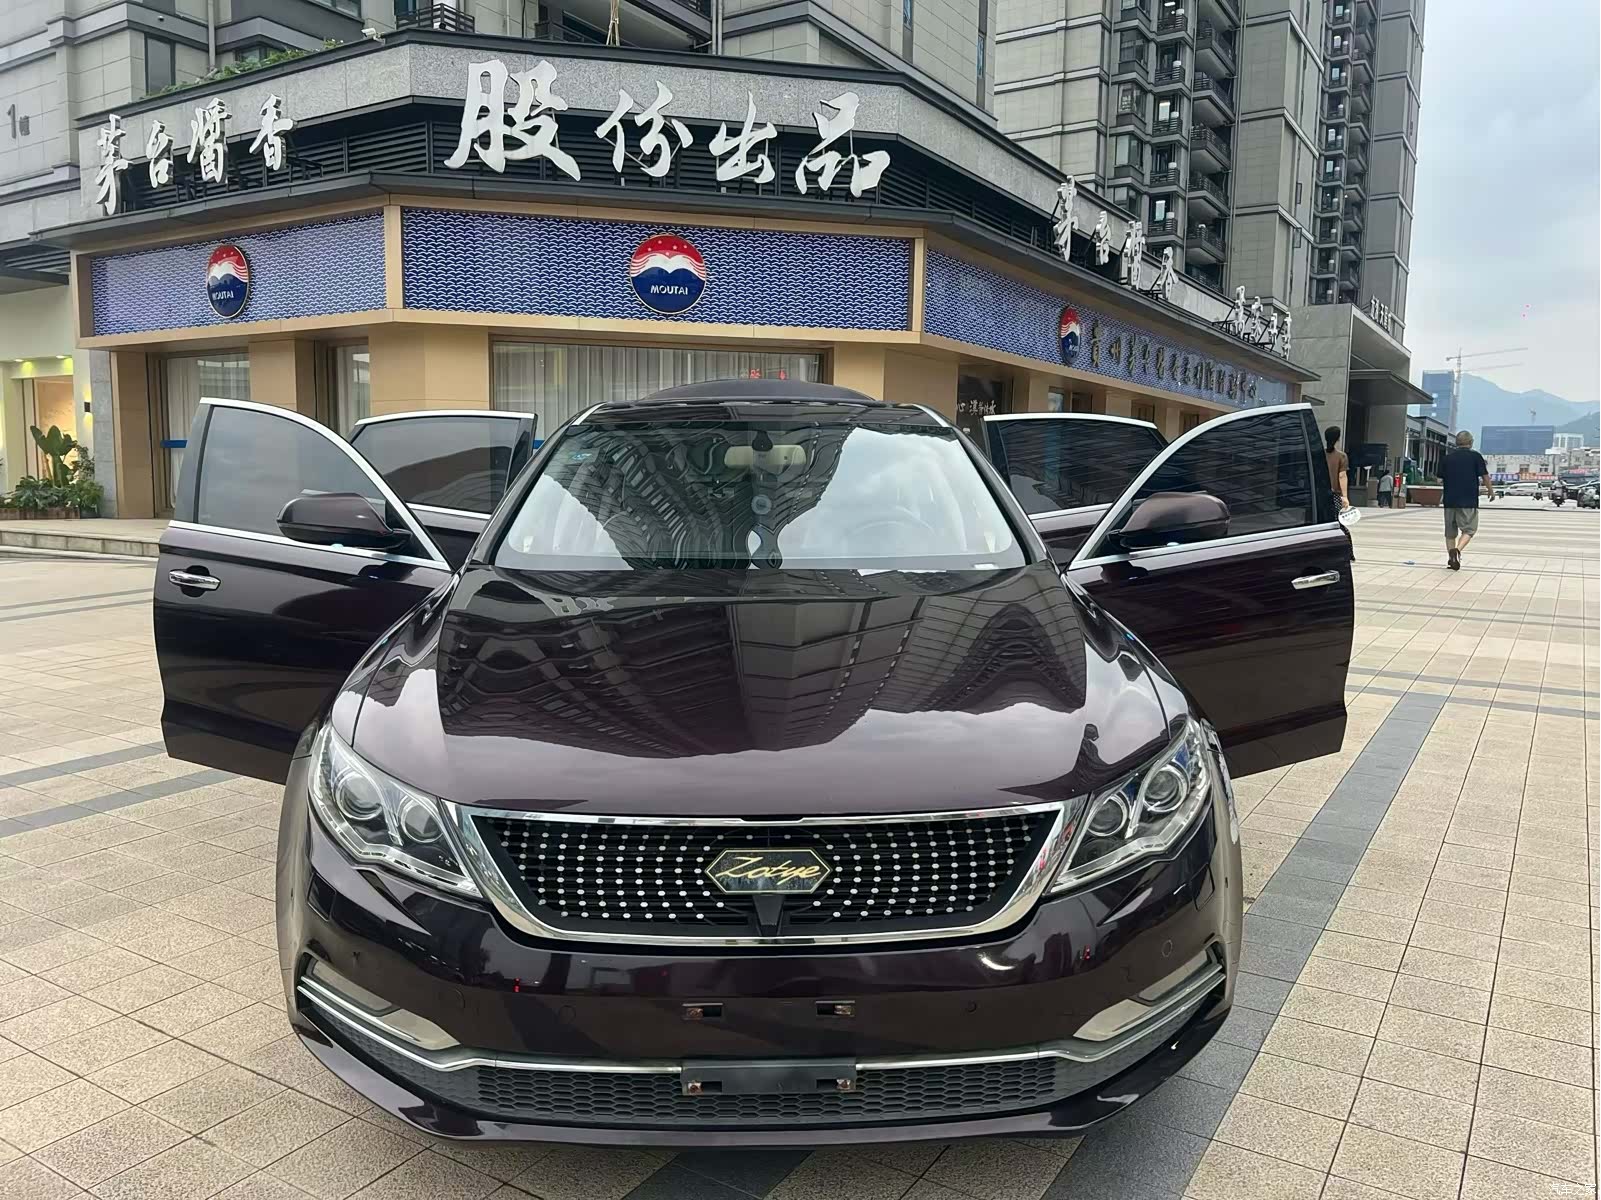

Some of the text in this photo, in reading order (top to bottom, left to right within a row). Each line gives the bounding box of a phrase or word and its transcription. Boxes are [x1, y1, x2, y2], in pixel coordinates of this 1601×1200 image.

[444, 59, 891, 197] 股份出品
[650, 285, 689, 296] MOUTAI
[715, 856, 821, 886] Zotye
